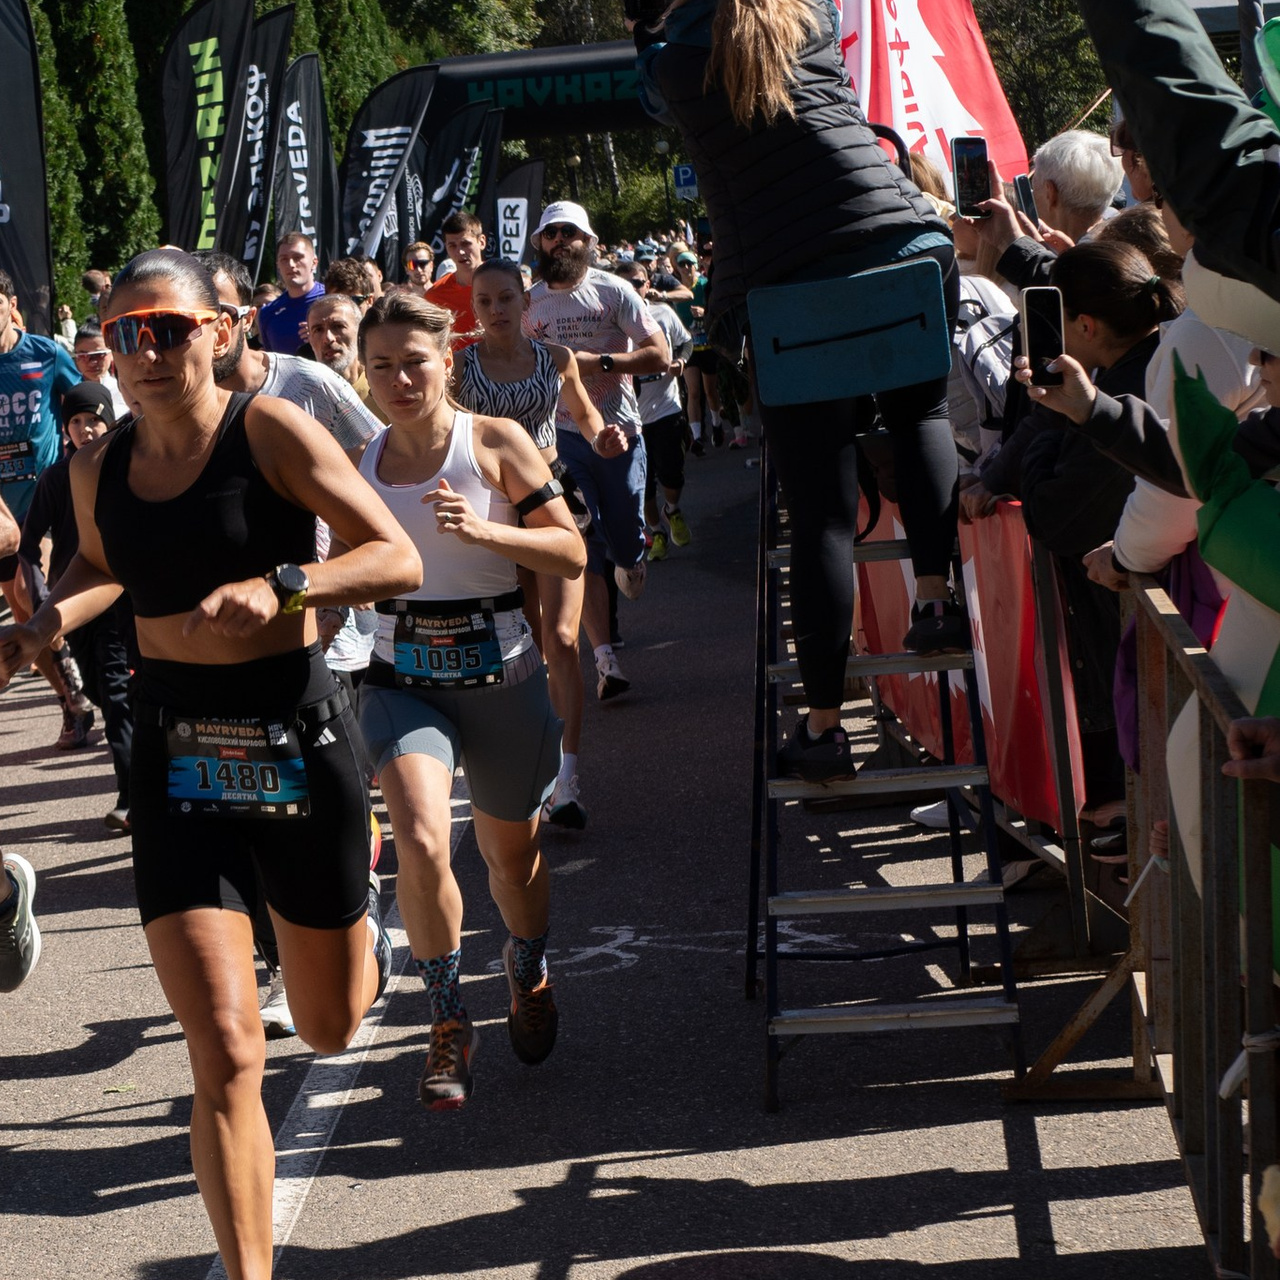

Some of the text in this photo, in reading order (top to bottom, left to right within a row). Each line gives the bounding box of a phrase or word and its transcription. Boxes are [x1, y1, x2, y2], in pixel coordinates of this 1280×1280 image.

[679, 167, 691, 185] P
[556, 316, 601, 324] EDELWEISS
[557, 331, 593, 339] RUNNING
[415, 616, 469, 627] MAYRVEDA
[411, 645, 482, 672] 1095
[195, 724, 265, 737] MAYRVEDA
[239, 739, 267, 747] МАРАФОН
[195, 760, 280, 794] 1480
[221, 792, 258, 801] ДЕСЯТКА
